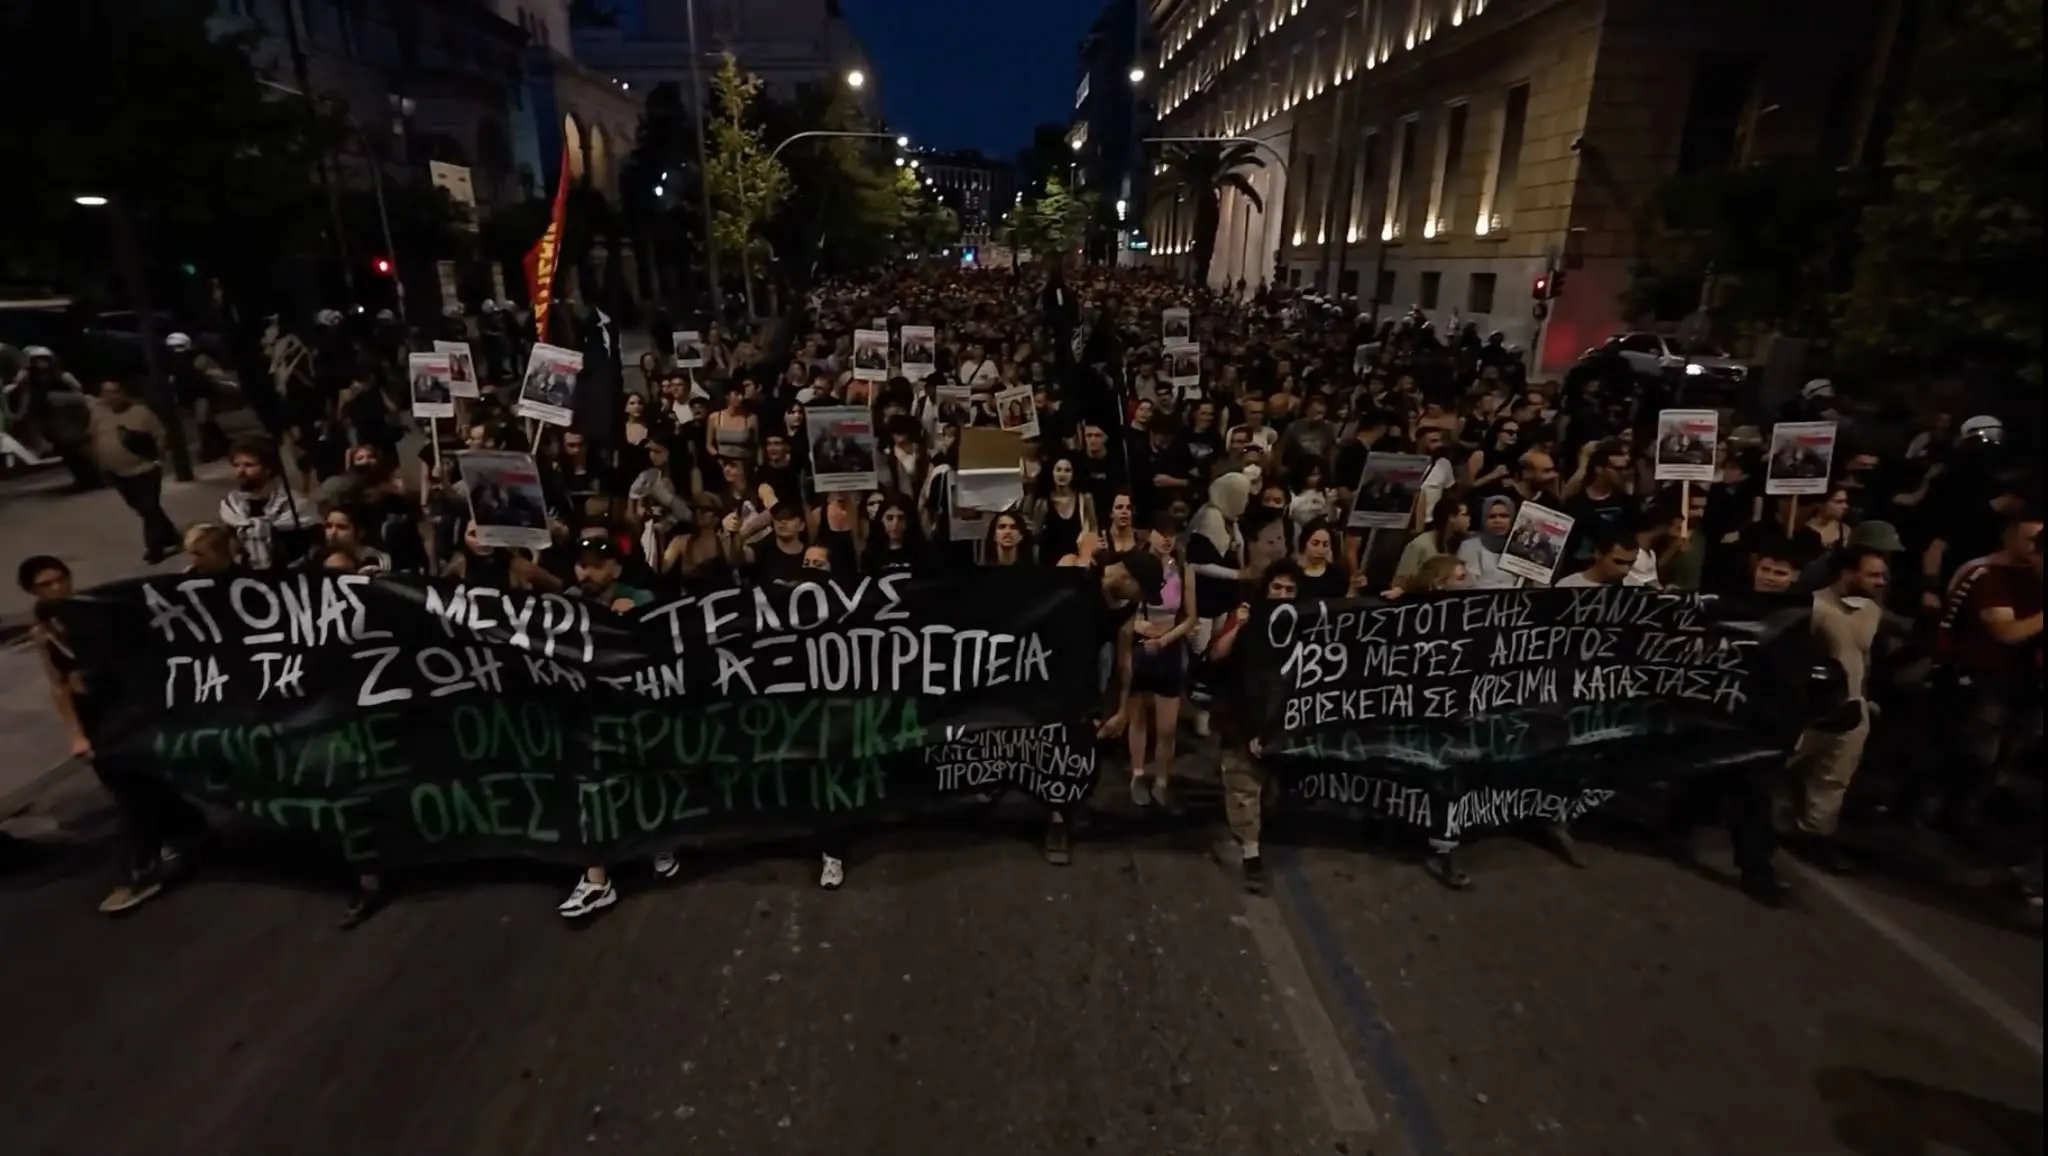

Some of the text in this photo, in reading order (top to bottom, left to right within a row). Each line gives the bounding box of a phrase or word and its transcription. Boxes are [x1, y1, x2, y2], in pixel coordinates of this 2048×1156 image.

[142, 572, 912, 663] ΑΓΩΝΑΣ ΜΕΧΡΙ ΤΕΛΟΥΣ
[1268, 602, 1298, 648] Ο
[1302, 590, 1535, 643] ΑΡΙΣΤΟΤΕΛΗΣ
[165, 653, 229, 709] ΓΙΑ
[250, 652, 306, 700] ΤΗ
[351, 646, 503, 706] ΖΩΗ
[712, 624, 1052, 695] ΑΞΙΟΠΡΕΠΕΙΑ
[1280, 640, 1348, 690] 139
[1364, 638, 1474, 677] ΜΕΡΕΣ
[1488, 625, 1622, 668] ΑΠΕΡΓΟΣ
[1284, 664, 1748, 730] ΒΡΙΣΚΕΤΑΙ ΣΕ ΚΡΙΣΙΜΗ ΚΑΤΑΣΤΑΣΗ
[411, 772, 560, 842] ΟΛΕΣ
[1298, 772, 1432, 828] ΟΙΝΟΤΗΤΑ
